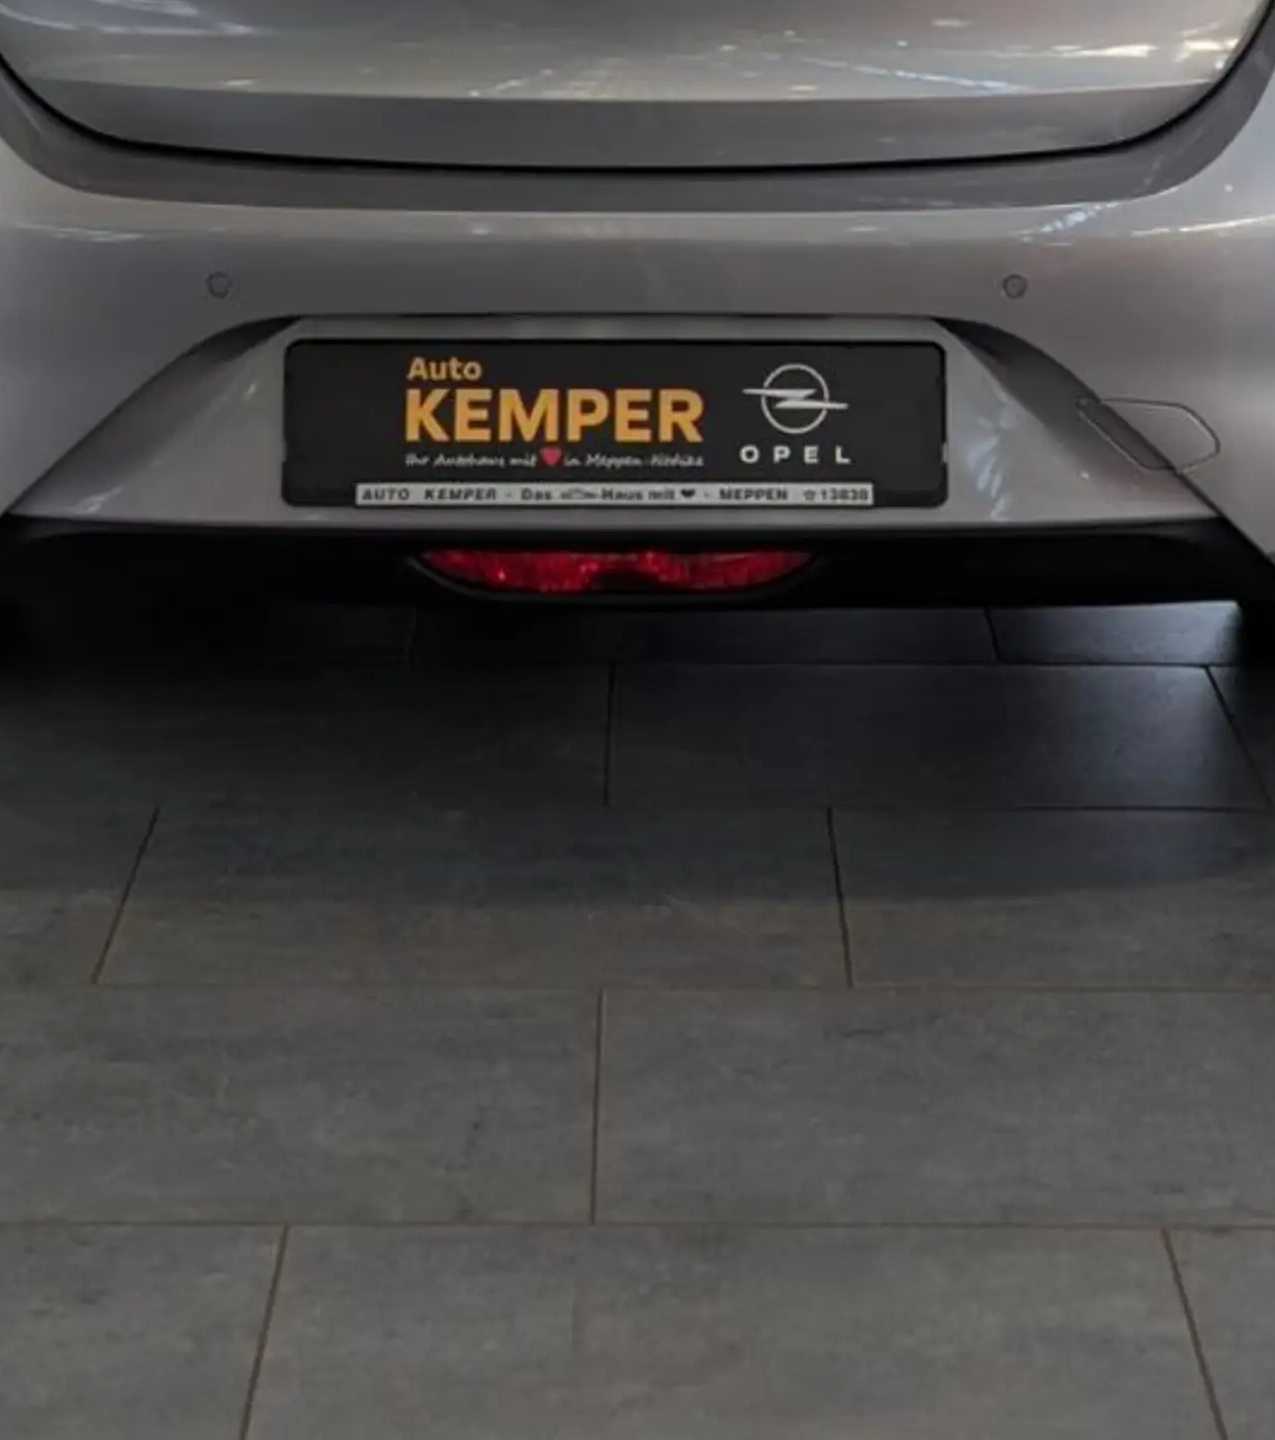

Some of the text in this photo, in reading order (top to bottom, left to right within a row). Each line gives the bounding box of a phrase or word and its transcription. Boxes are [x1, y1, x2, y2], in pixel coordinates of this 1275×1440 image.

[406, 356, 482, 381] Auto
[405, 388, 704, 443] KEMPER
[739, 444, 852, 464] OPEL
[362, 488, 410, 501] AUTO
[424, 488, 498, 501] KEMPER
[521, 488, 553, 501] Das
[719, 488, 788, 501] MEPPEN
